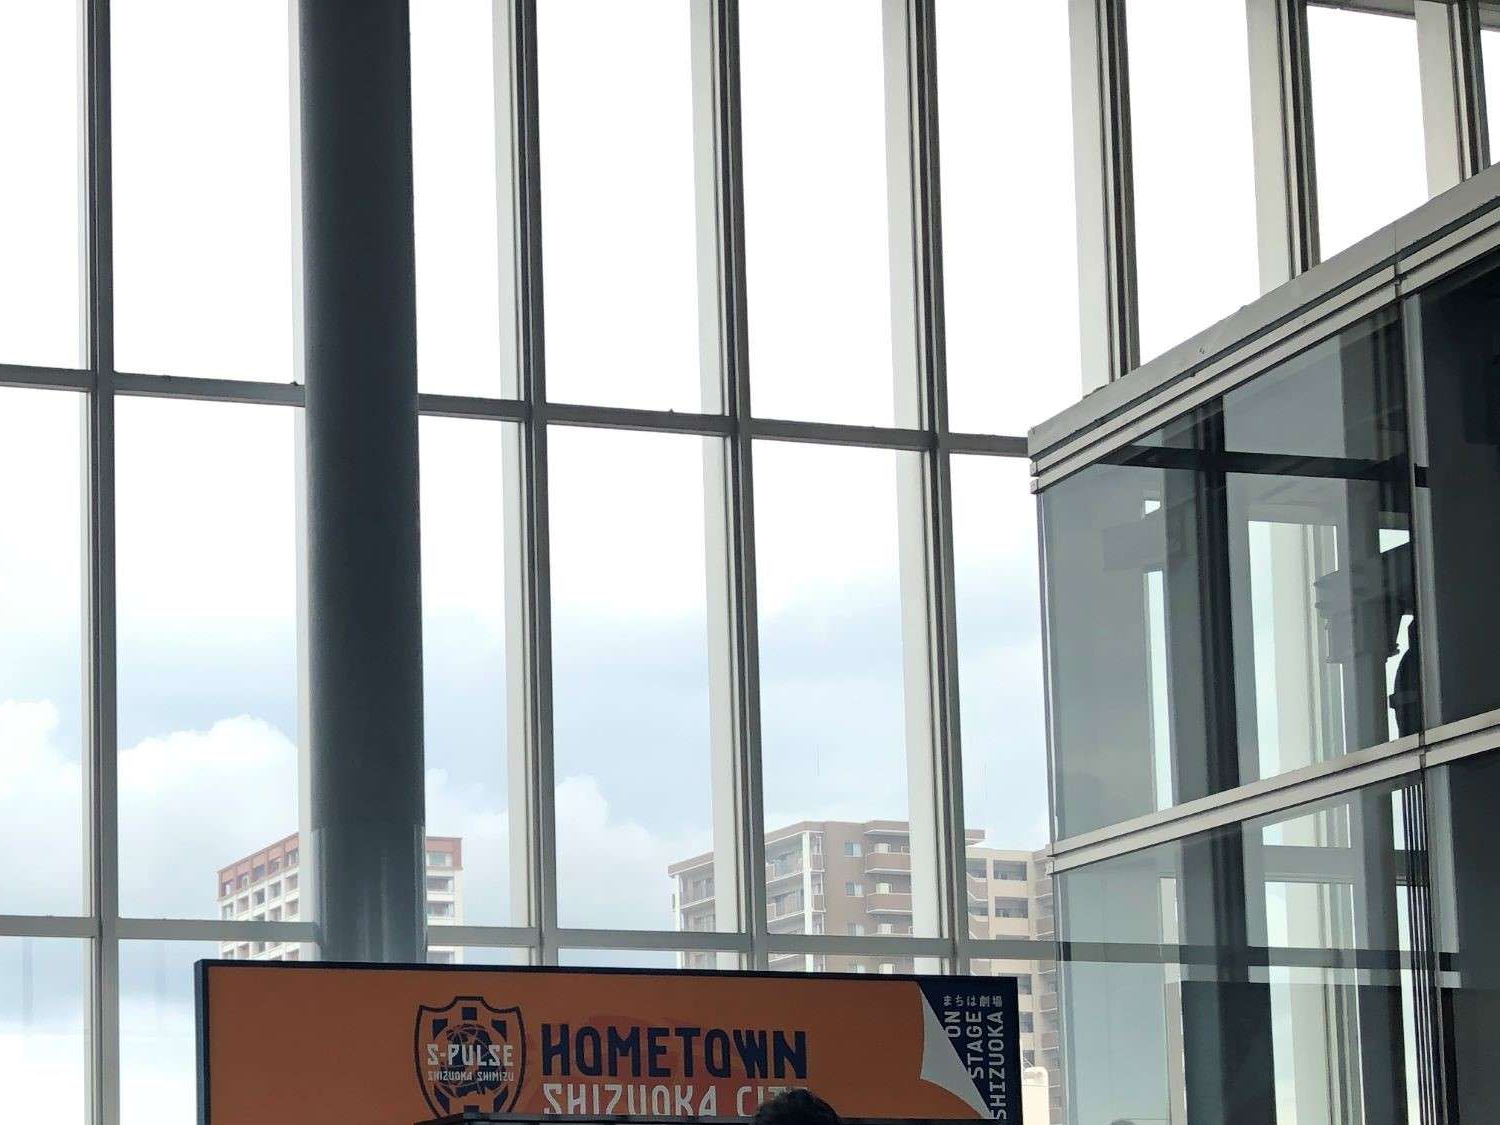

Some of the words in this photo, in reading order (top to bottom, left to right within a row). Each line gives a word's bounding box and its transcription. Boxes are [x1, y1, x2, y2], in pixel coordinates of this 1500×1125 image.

[944, 1011, 961, 1038] ON
[427, 1043, 514, 1067] S-PULSE
[541, 1023, 807, 1080] HOMETOWN
[965, 1011, 984, 1079] STAGE
[427, 1070, 473, 1081] SHIZUOKA
[476, 1071, 515, 1082] SHIMIZU
[986, 1011, 1007, 1120] SHIZUOKA
[543, 1083, 718, 1117] SHIZUOKA
